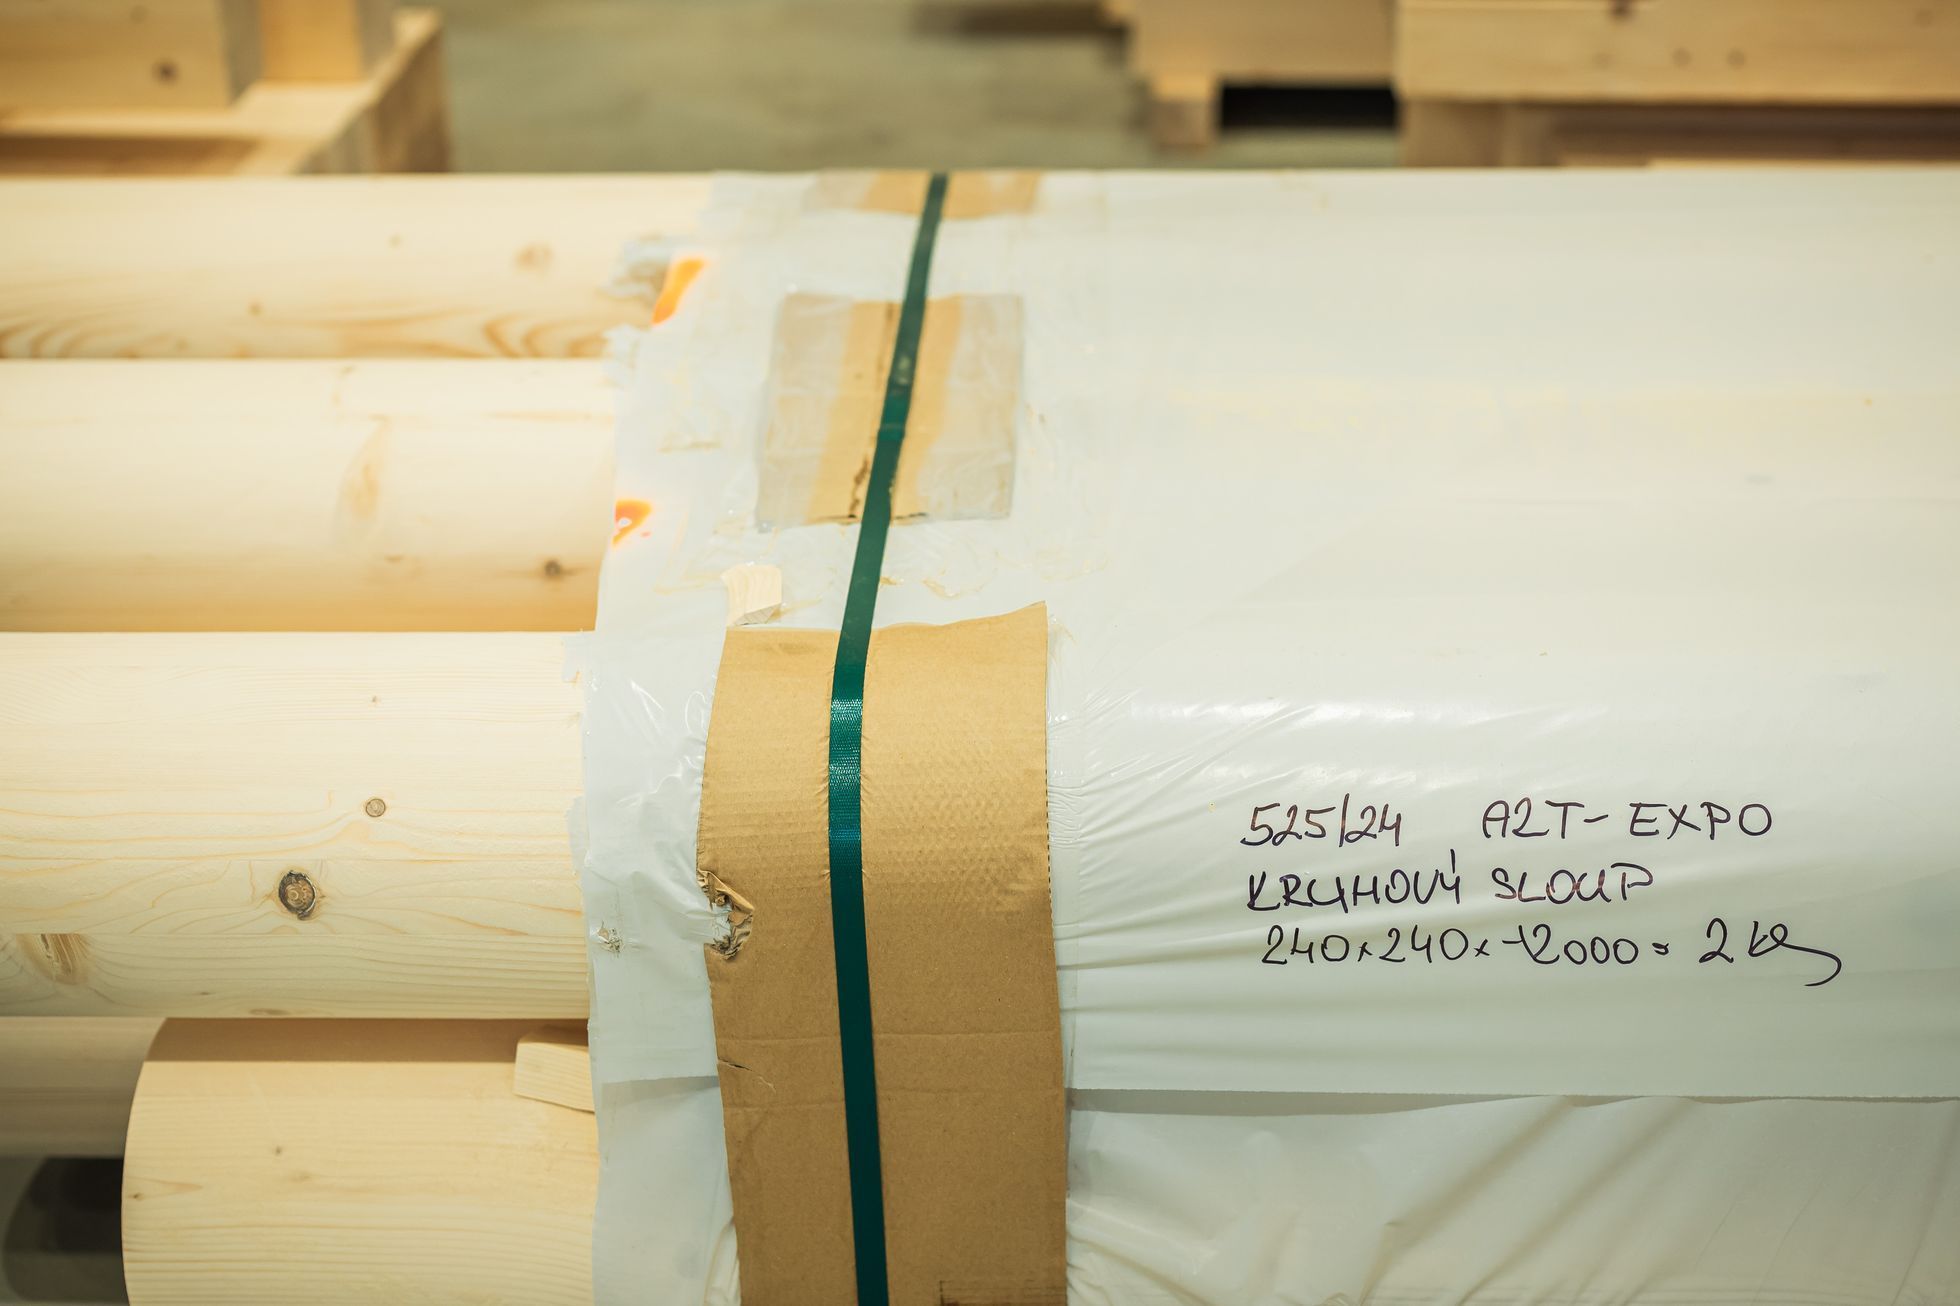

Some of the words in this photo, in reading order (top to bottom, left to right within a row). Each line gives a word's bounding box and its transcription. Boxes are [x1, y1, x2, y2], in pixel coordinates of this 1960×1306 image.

[1239, 793, 1403, 848] 525/24
[1628, 801, 1773, 840] EXPO
[1491, 862, 1654, 905] SLOUP
[1698, 917, 1735, 964] 2
